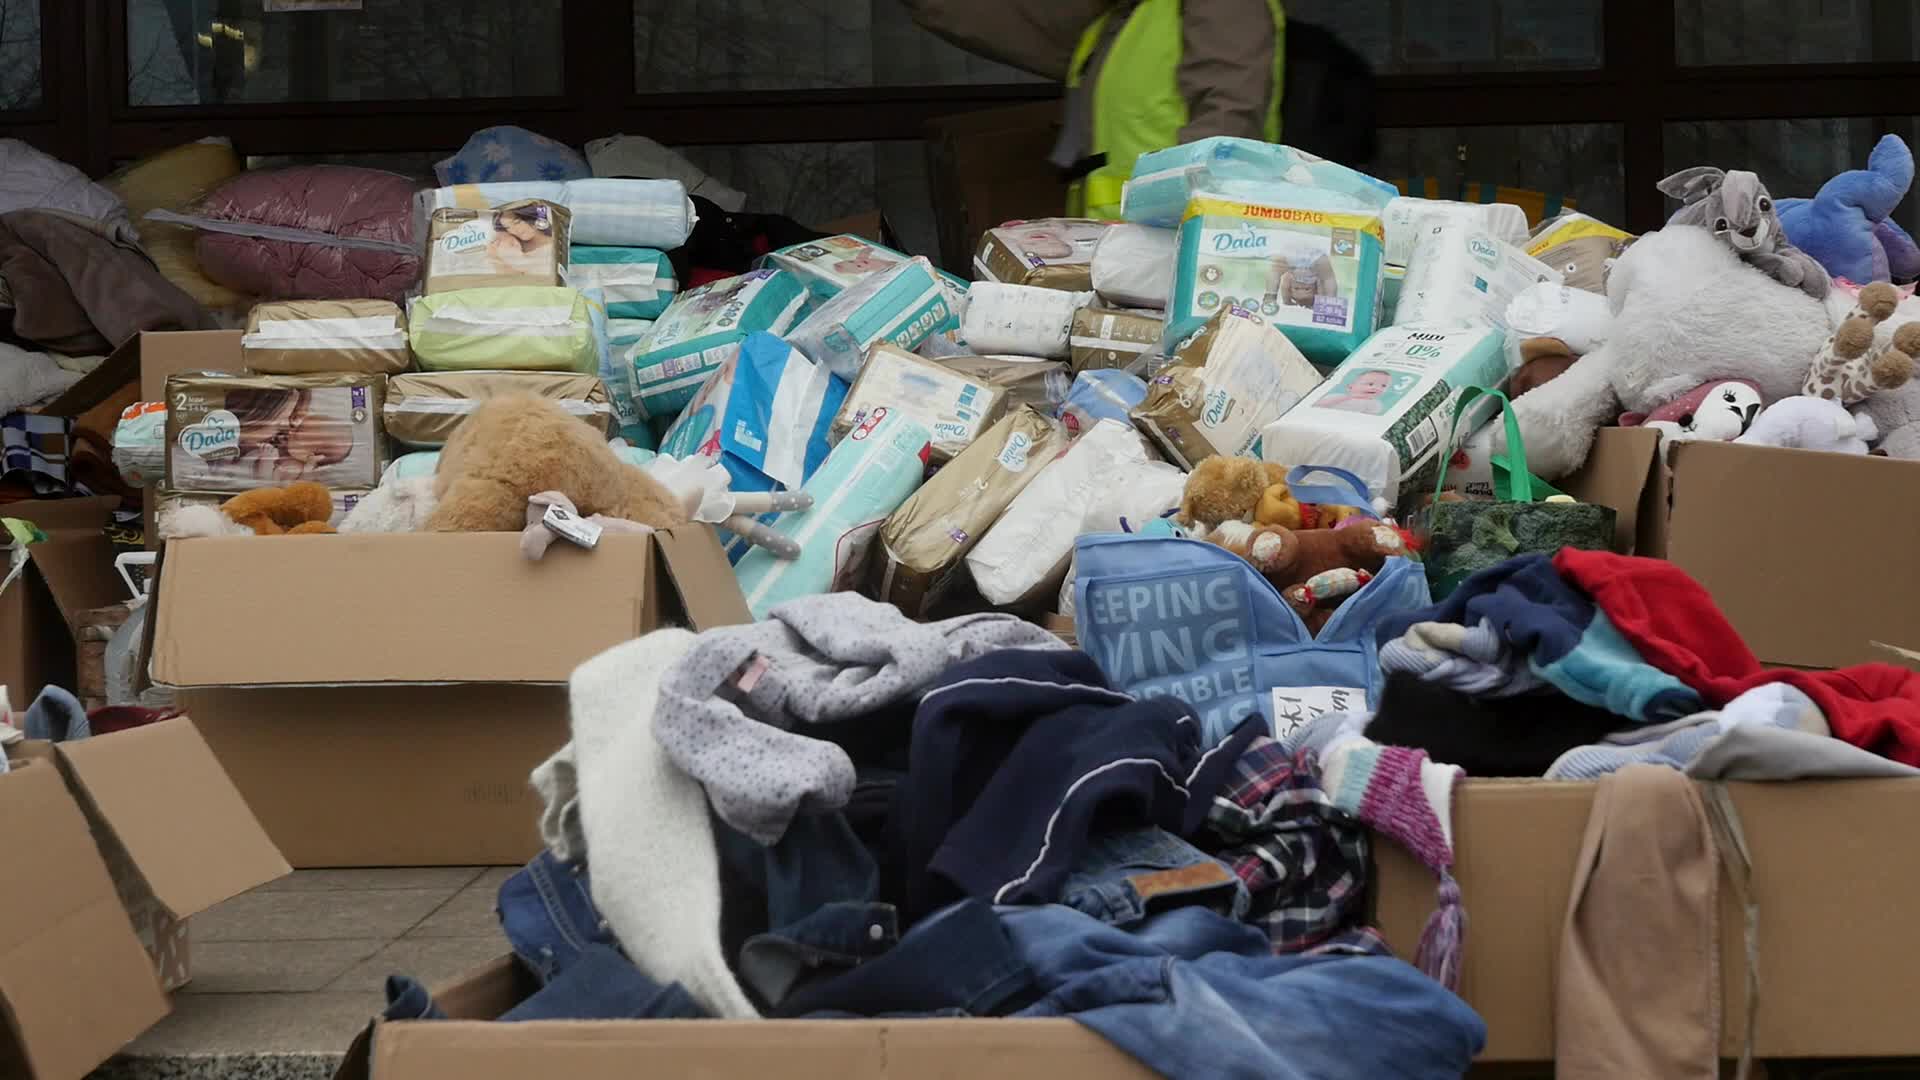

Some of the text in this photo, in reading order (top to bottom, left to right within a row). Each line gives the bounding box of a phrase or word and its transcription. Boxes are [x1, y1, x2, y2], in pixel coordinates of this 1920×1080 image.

[1243, 205, 1323, 223] JUMBOBAG
[446, 230, 486, 250] Dada
[1212, 231, 1267, 252] Dada
[1406, 344, 1441, 357] 0%
[176, 393, 187, 410] 2
[1206, 389, 1227, 424] Dada
[185, 427, 236, 451] Dada
[934, 423, 966, 436] Dada
[1003, 434, 1027, 463] Dada
[1092, 576, 1239, 624] EEPING
[1102, 618, 1248, 682] VING
